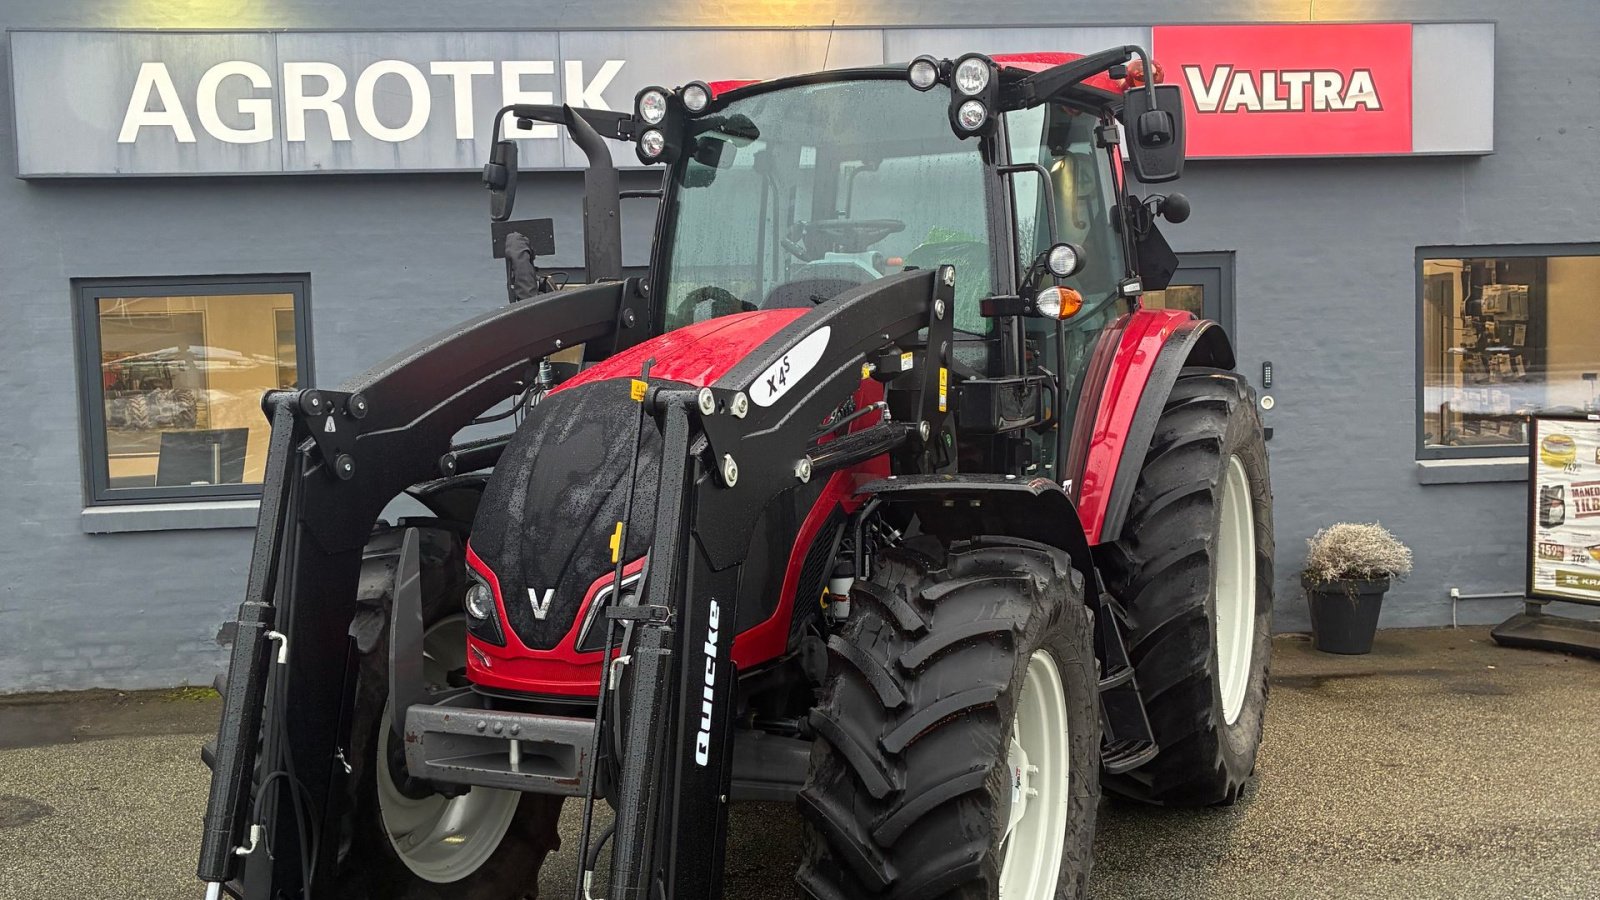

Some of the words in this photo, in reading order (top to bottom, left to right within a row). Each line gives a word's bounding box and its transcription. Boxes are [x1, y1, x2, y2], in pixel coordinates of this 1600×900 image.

[117, 59, 626, 143] AGROTEK
[1182, 64, 1383, 113] VALTRA
[527, 587, 556, 620] V
